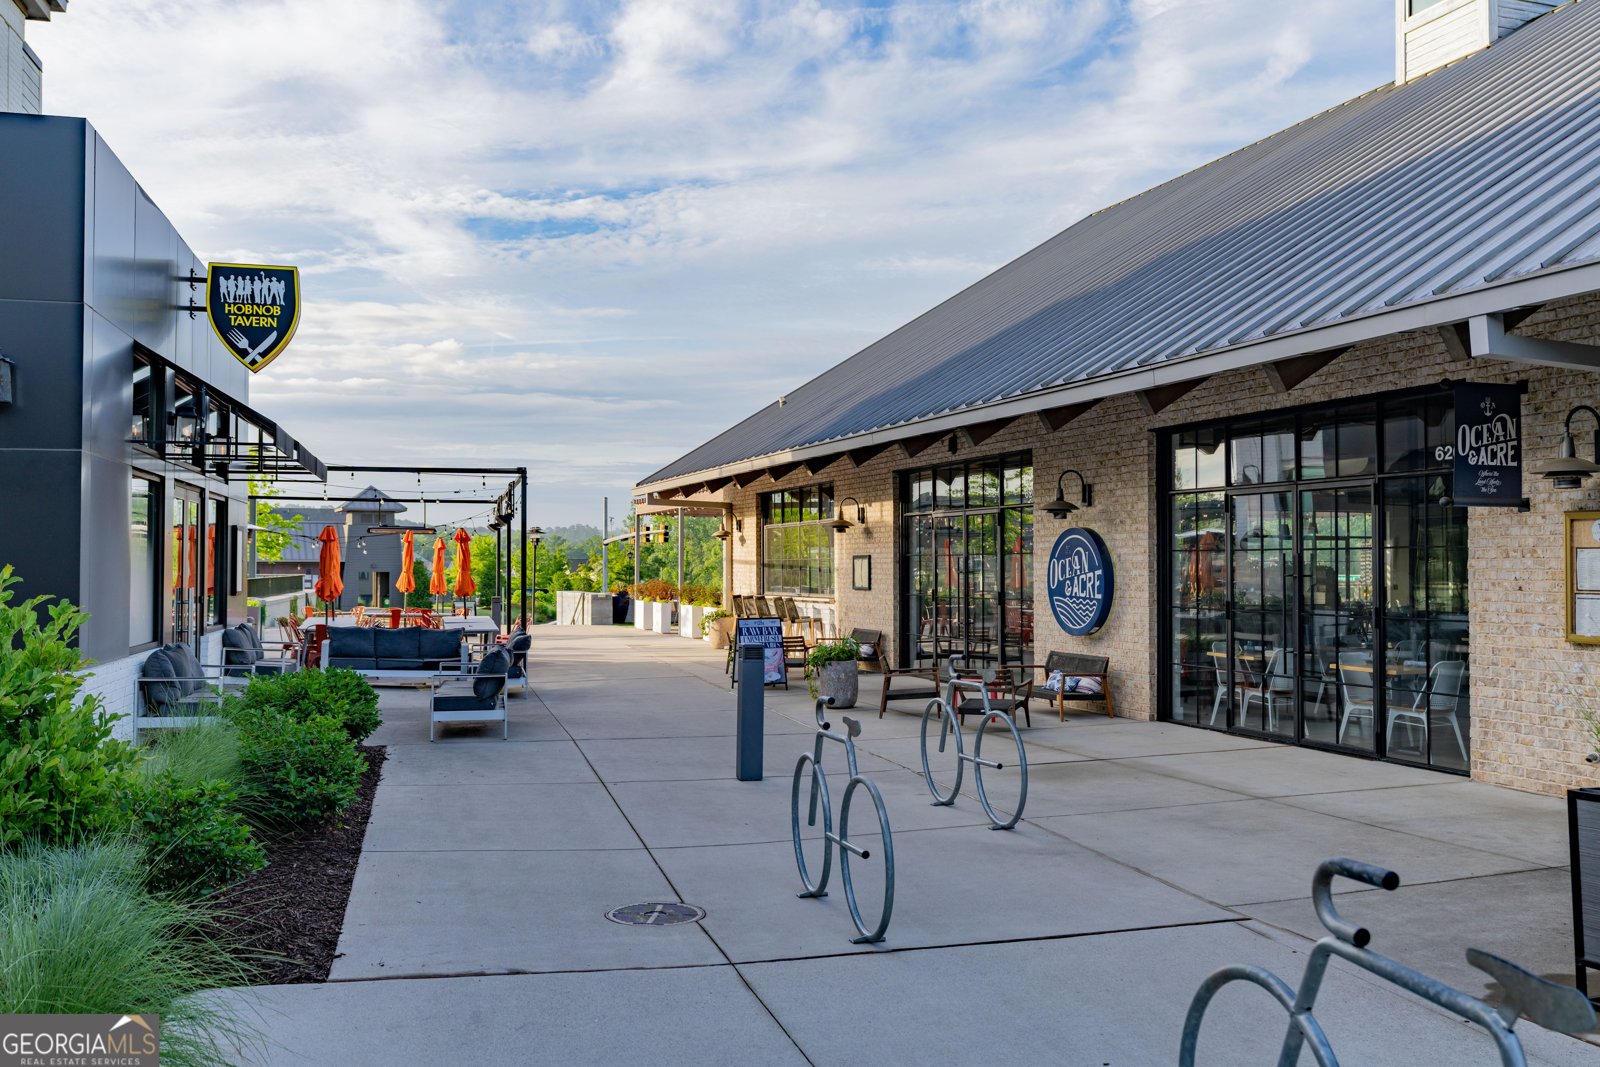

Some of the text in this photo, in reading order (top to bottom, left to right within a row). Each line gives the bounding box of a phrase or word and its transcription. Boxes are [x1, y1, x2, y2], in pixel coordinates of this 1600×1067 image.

[224, 303, 281, 316] HOBNOB
[229, 315, 278, 328] TAVERN
[1457, 413, 1518, 456] OCEAN
[1435, 445, 1455, 461] 62
[1049, 547, 1089, 589] OCEAN
[742, 626, 779, 636] RAW BAR
